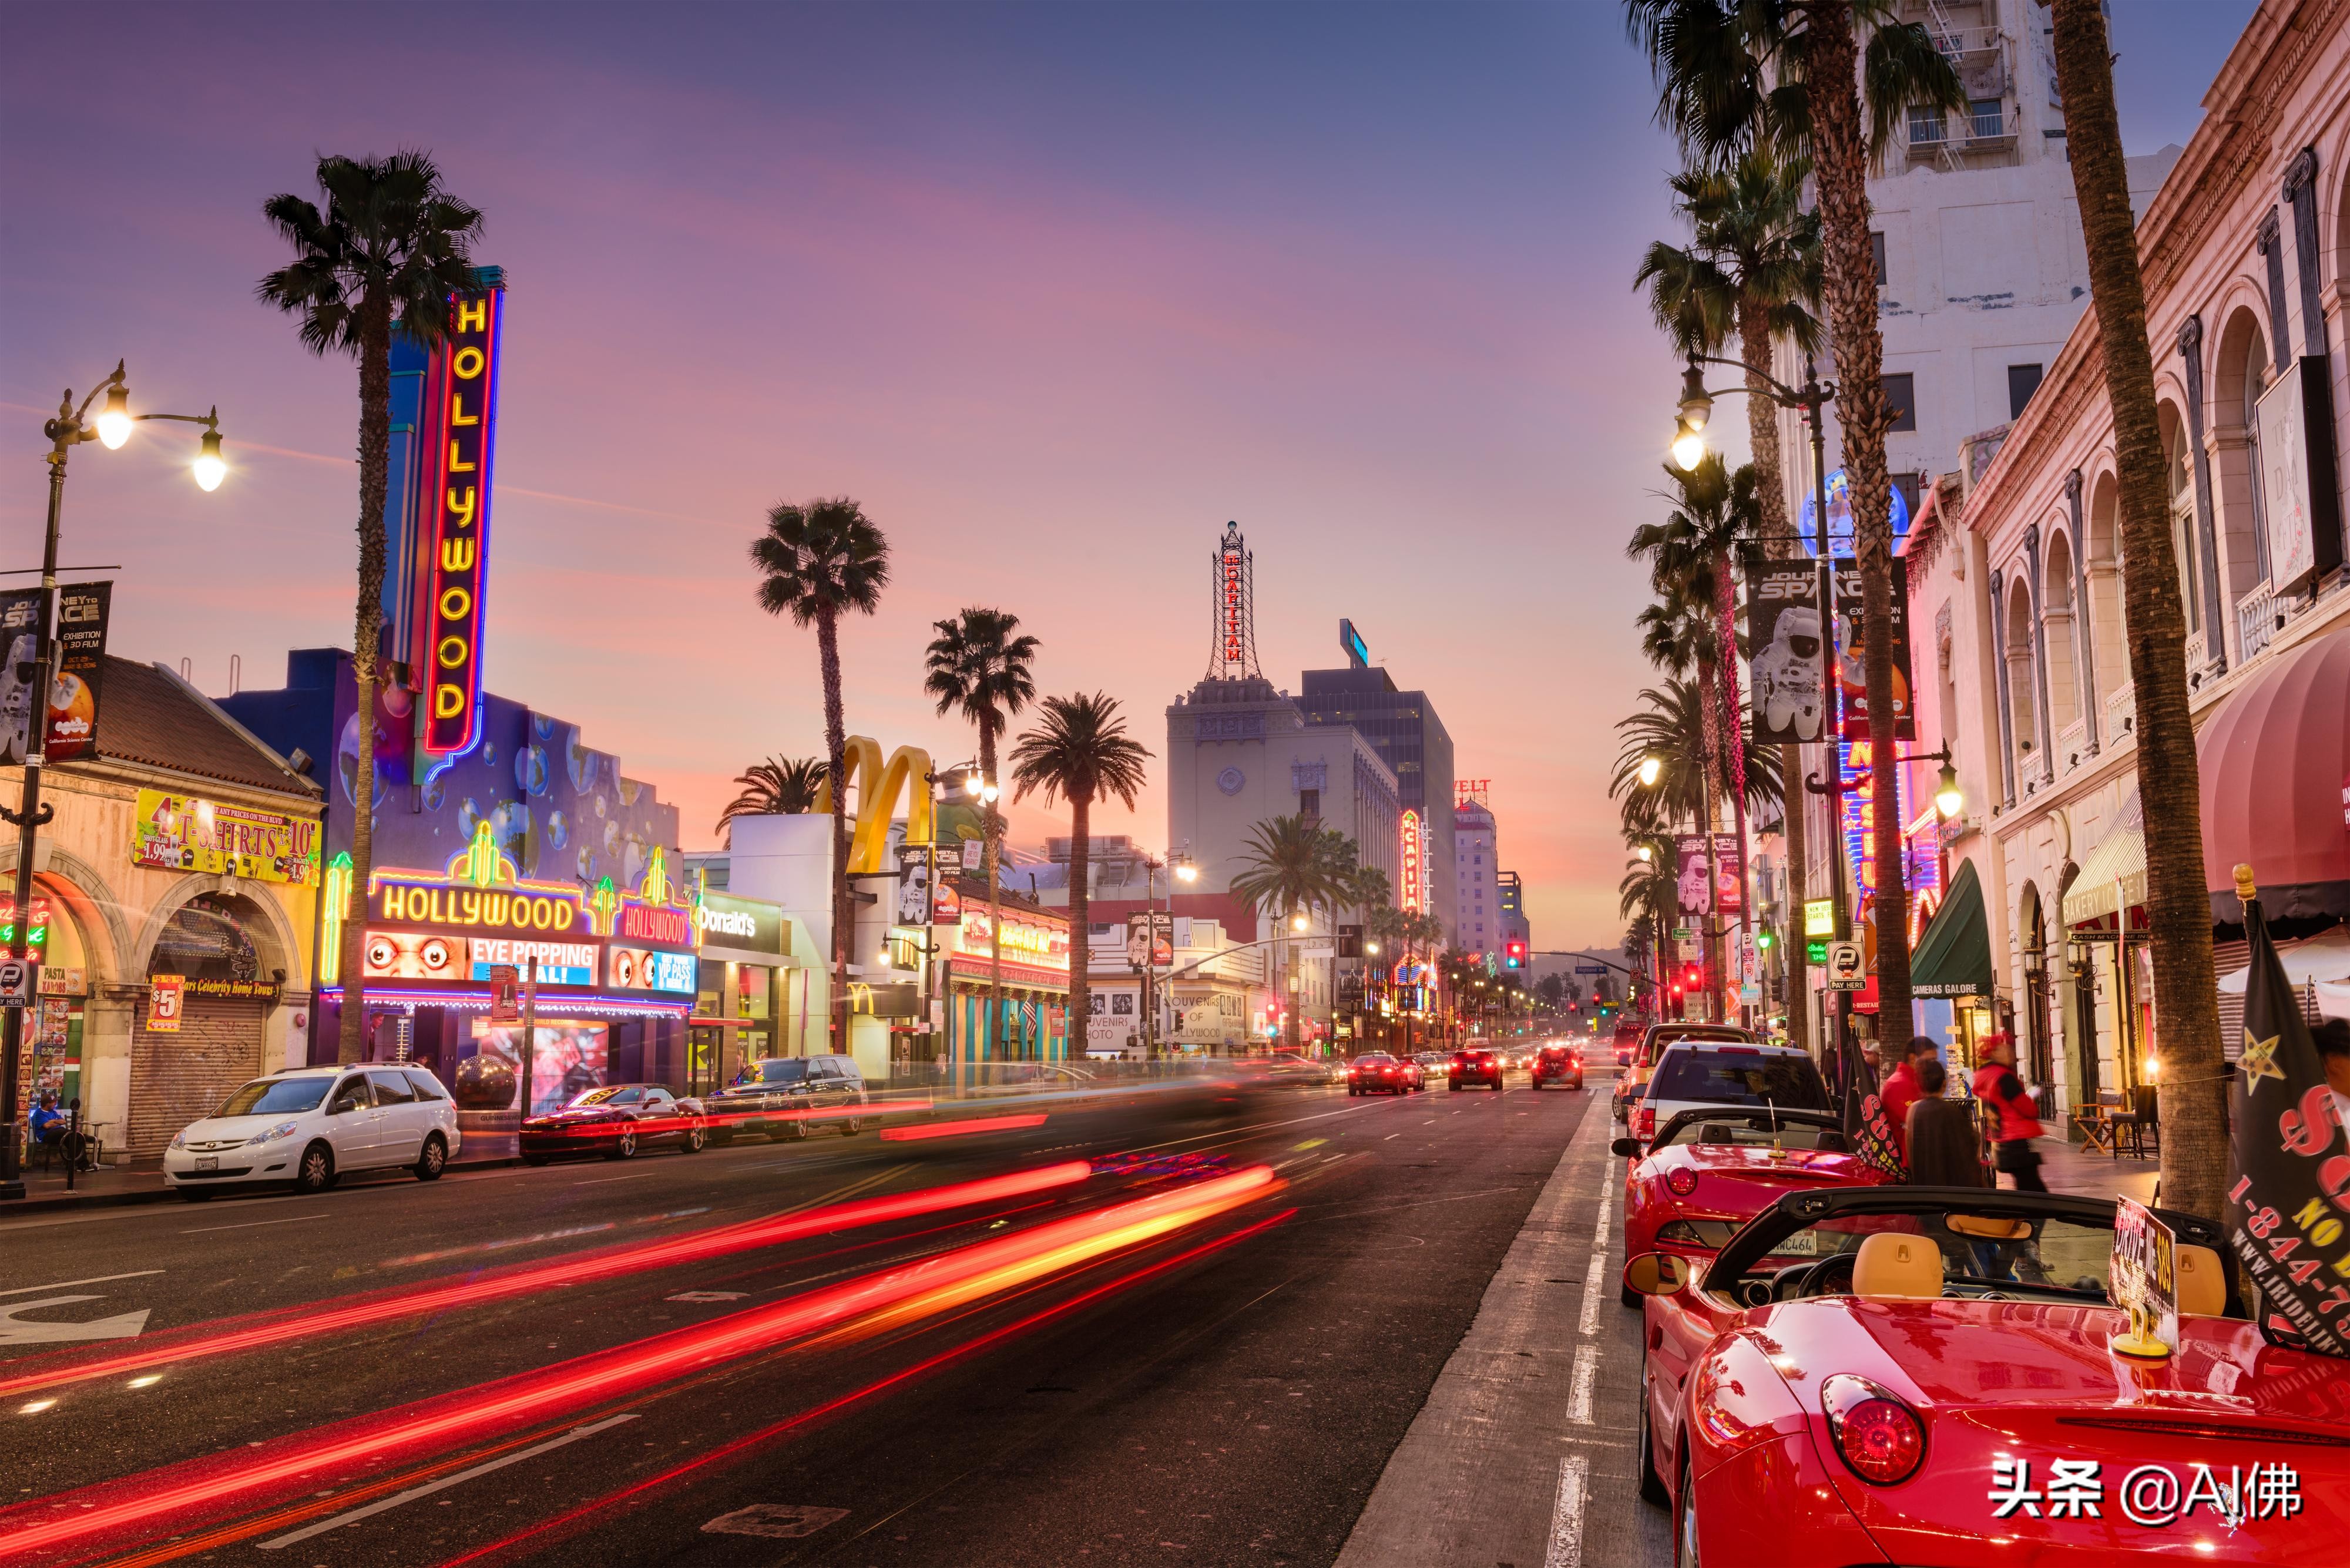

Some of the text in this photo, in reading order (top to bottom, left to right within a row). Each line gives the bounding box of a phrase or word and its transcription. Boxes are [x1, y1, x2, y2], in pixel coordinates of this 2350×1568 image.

[437, 298, 486, 720] HOLLYWOOD
[1224, 554, 1239, 565] EL
[1226, 566, 1241, 661] CAPITAN
[63, 631, 101, 640] EXHIBITION
[82, 640, 99, 648] FILM
[151, 796, 173, 834] 4
[231, 810, 249, 819] PRICES
[258, 814, 268, 823] THE
[269, 817, 283, 825] BLVD
[1404, 820, 1416, 830] EL
[1405, 831, 1417, 908] CAPITA
[384, 885, 573, 931] HOLLYWOOD
[2063, 889, 2099, 923] BAKERY
[625, 908, 685, 942] HOLLYWOOD
[1807, 912, 1824, 921] STARTS
[472, 939, 593, 966] EYE POPPING
[44, 968, 65, 981] PASTA
[658, 962, 691, 980] VIP PASS
[42, 981, 66, 994] KABOBS
[197, 978, 231, 997] Celebrity
[231, 981, 253, 995] Home
[254, 982, 274, 996] Tours
[1912, 983, 1977, 995] CAMERAS GALORE
[152, 989, 176, 1018] $5
[1172, 996, 1220, 1007] OUVENIRS
[1189, 1012, 1204, 1022] OF
[2292, 1197, 2344, 1248] NO
[2157, 1228, 2171, 1293] $89
